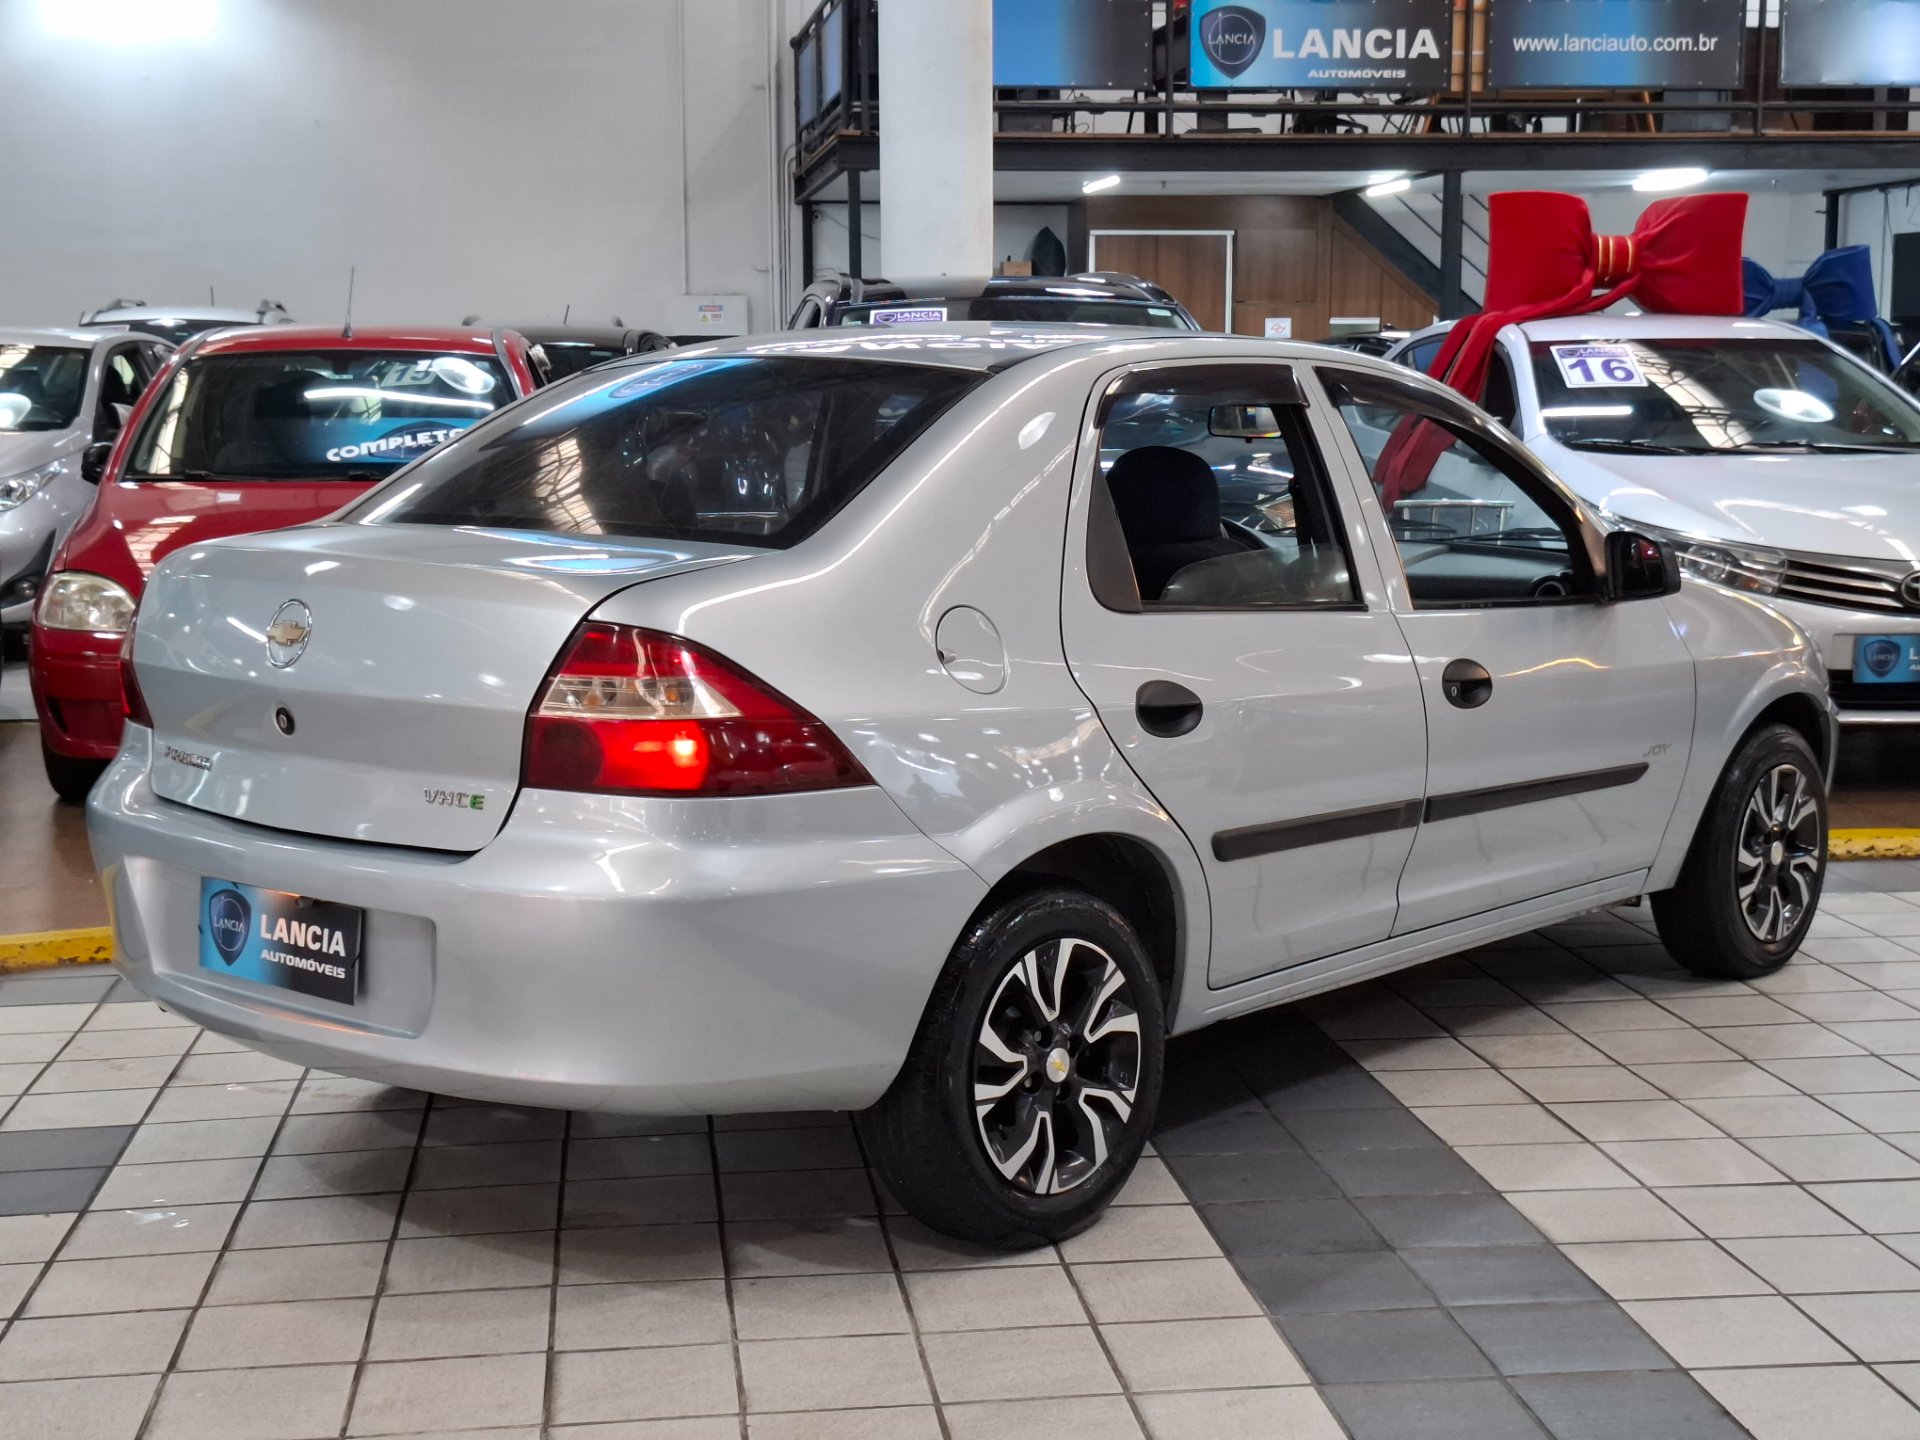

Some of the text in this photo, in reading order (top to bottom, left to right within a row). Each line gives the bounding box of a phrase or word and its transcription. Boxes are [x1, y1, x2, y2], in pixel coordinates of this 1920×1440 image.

[1208, 33, 1256, 45] LANCIA
[1272, 28, 1440, 59] LANCIA
[1513, 33, 1718, 53] www.lanciauto.com.br
[897, 311, 941, 319] LANCIA
[1567, 358, 1635, 382] 16
[213, 915, 245, 934] LANCIA
[259, 913, 347, 958] LANCIA
[260, 948, 347, 980] AUTOMÓVEIS
